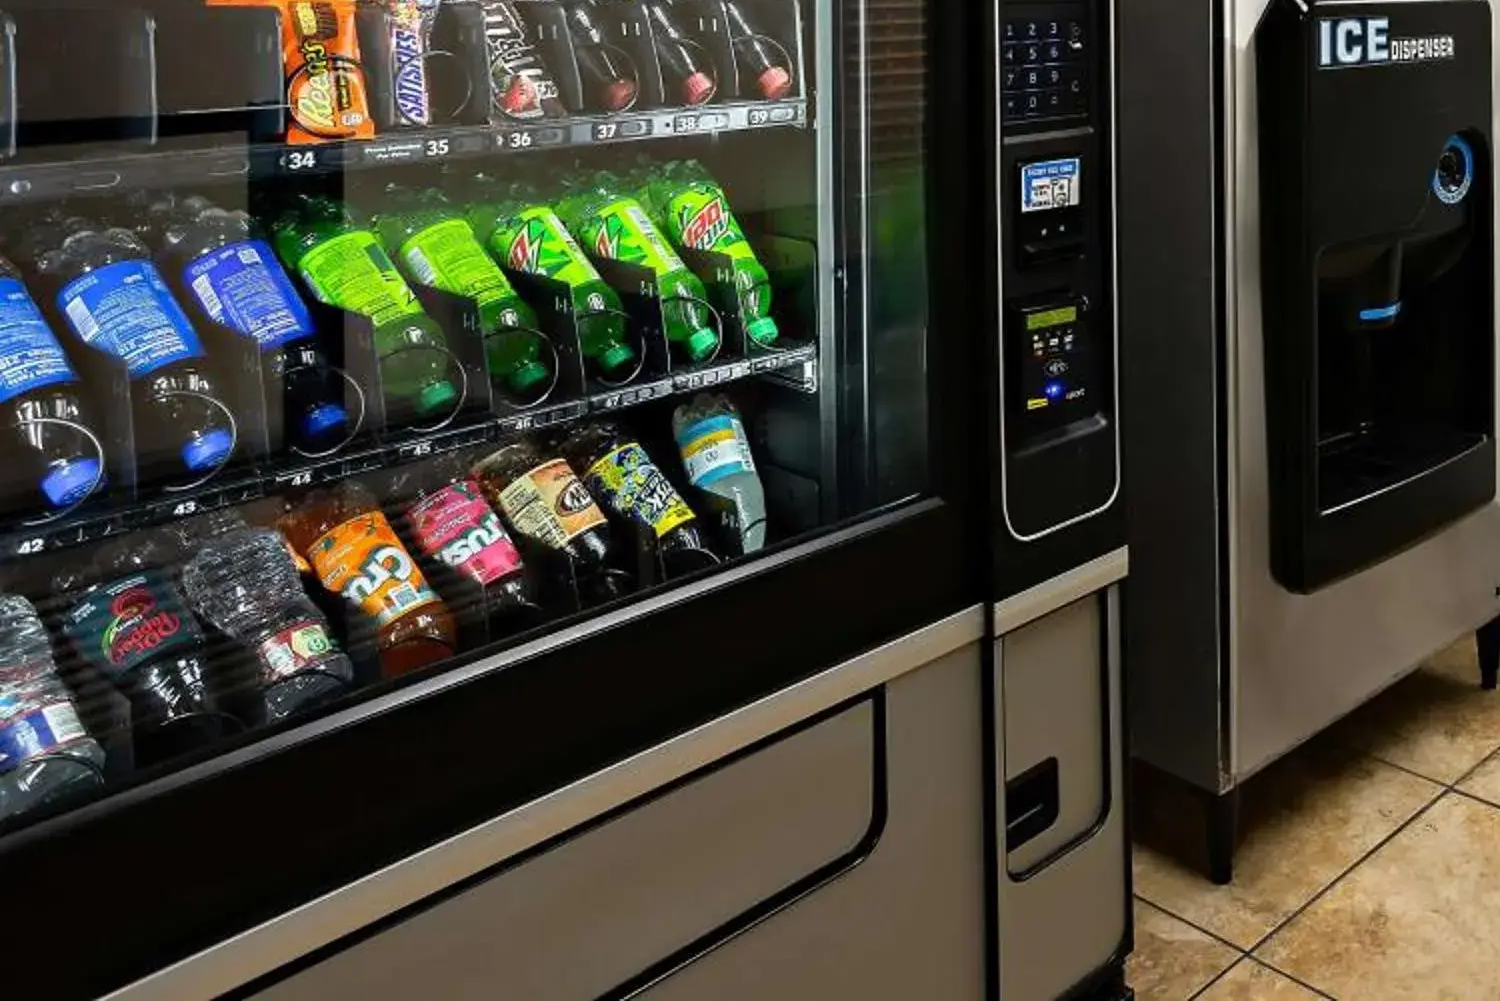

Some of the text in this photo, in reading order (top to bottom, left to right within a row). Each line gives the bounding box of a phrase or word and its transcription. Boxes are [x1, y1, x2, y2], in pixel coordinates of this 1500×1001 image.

[1319, 18, 1454, 66] ICE DISPENSER
[676, 117, 696, 132] 38
[749, 110, 768, 124] 39
[511, 132, 531, 148] 36
[599, 124, 617, 139] 37
[427, 139, 449, 156] 35
[288, 151, 317, 170] 34
[173, 500, 197, 516] 43
[17, 538, 45, 555] 42
[432, 512, 504, 566] rus
[341, 546, 413, 604] Cru
